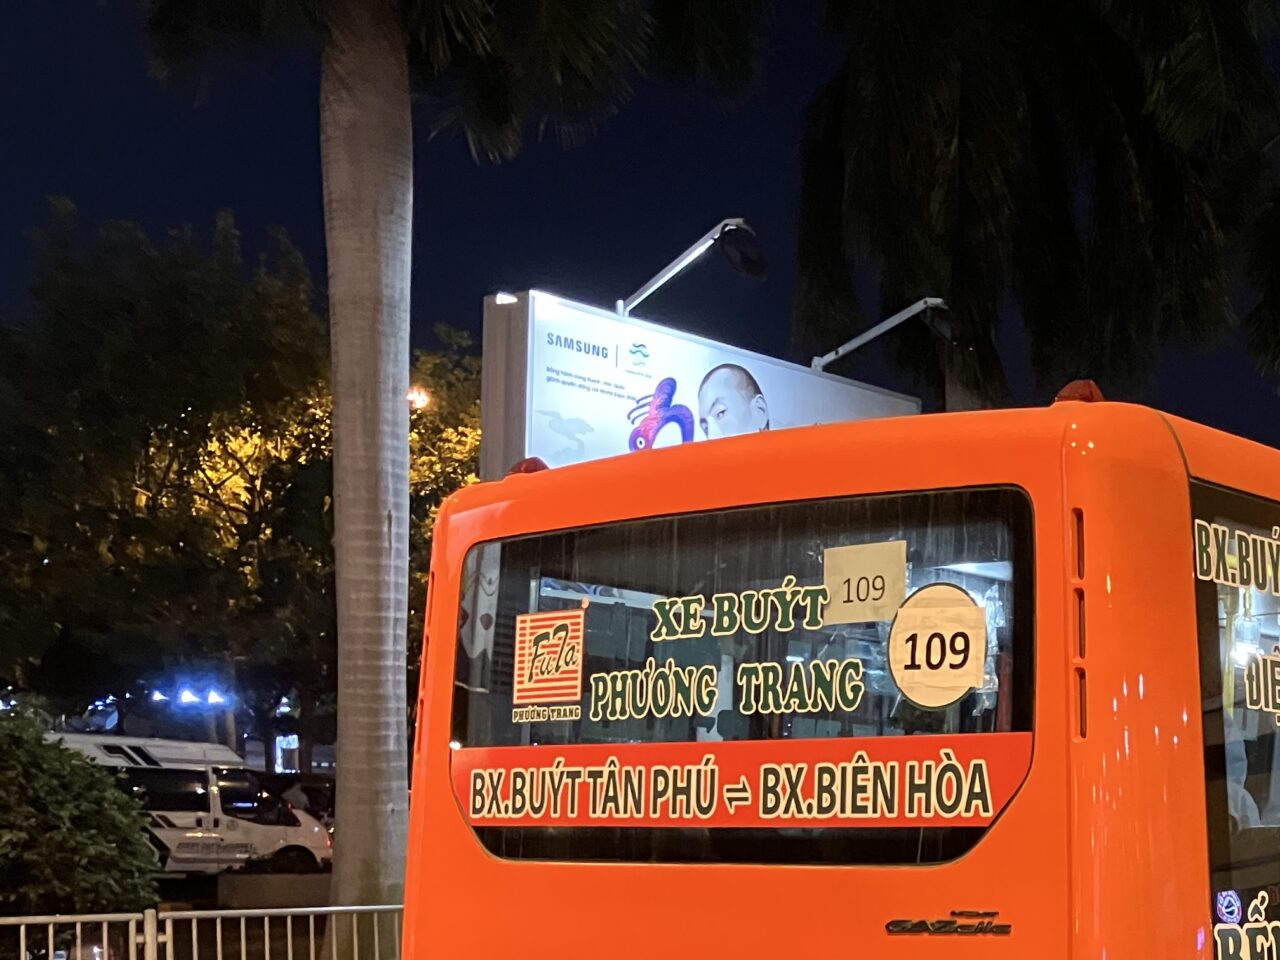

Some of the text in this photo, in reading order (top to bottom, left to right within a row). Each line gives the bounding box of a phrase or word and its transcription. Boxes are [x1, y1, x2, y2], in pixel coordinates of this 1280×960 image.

[546, 332, 609, 359] SAMSUNG
[651, 575, 829, 641] XE BUÝT
[842, 574, 887, 604] 109
[903, 630, 971, 672] 109
[591, 657, 864, 721] PHƯƠNG TRANG
[548, 705, 581, 720] TRANG
[469, 748, 993, 818] BX.BUÝT TÂN PHÚ BX.BIÊN HÒA
